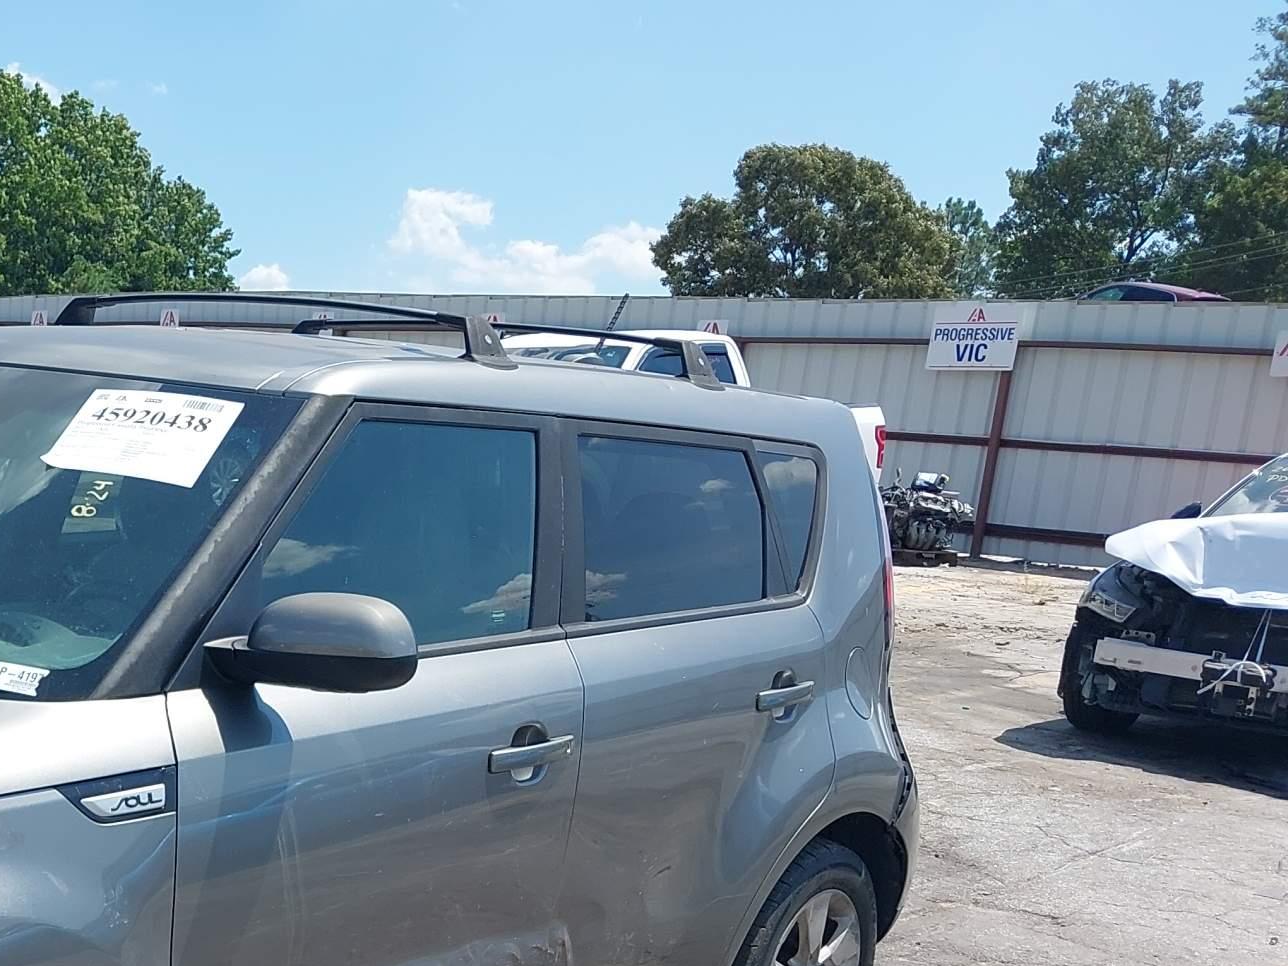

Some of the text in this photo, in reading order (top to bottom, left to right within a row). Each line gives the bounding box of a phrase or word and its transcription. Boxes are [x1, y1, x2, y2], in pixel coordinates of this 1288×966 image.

[934, 327, 1016, 342] PROGRESSIVE
[955, 343, 988, 363] VIC
[91, 406, 212, 433] 45920438
[110, 792, 163, 812] SOUL
